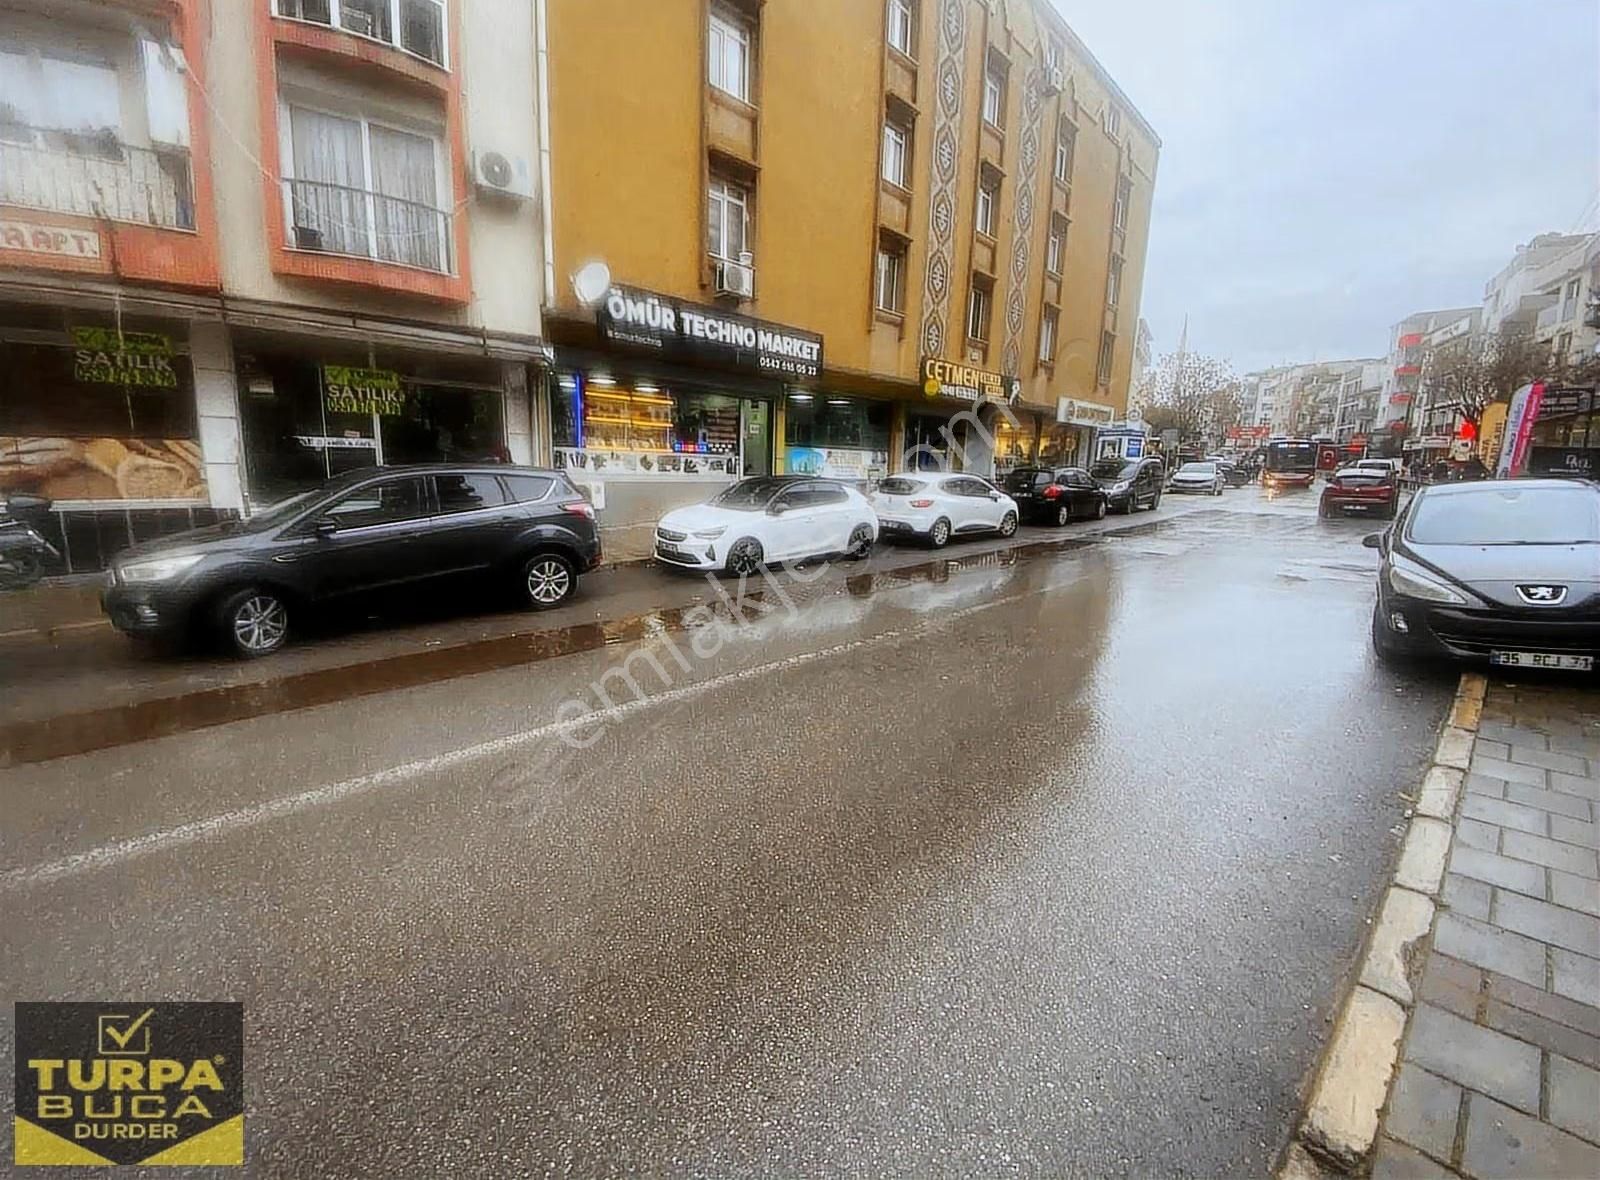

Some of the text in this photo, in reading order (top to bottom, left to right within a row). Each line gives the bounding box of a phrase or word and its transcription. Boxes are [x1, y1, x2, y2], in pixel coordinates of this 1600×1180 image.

[608, 288, 820, 361] ÖMÜR TECHNO MARKET
[76, 350, 172, 371] SATILIK
[327, 384, 398, 403] SATILIK
[1501, 652, 1520, 665] 35
